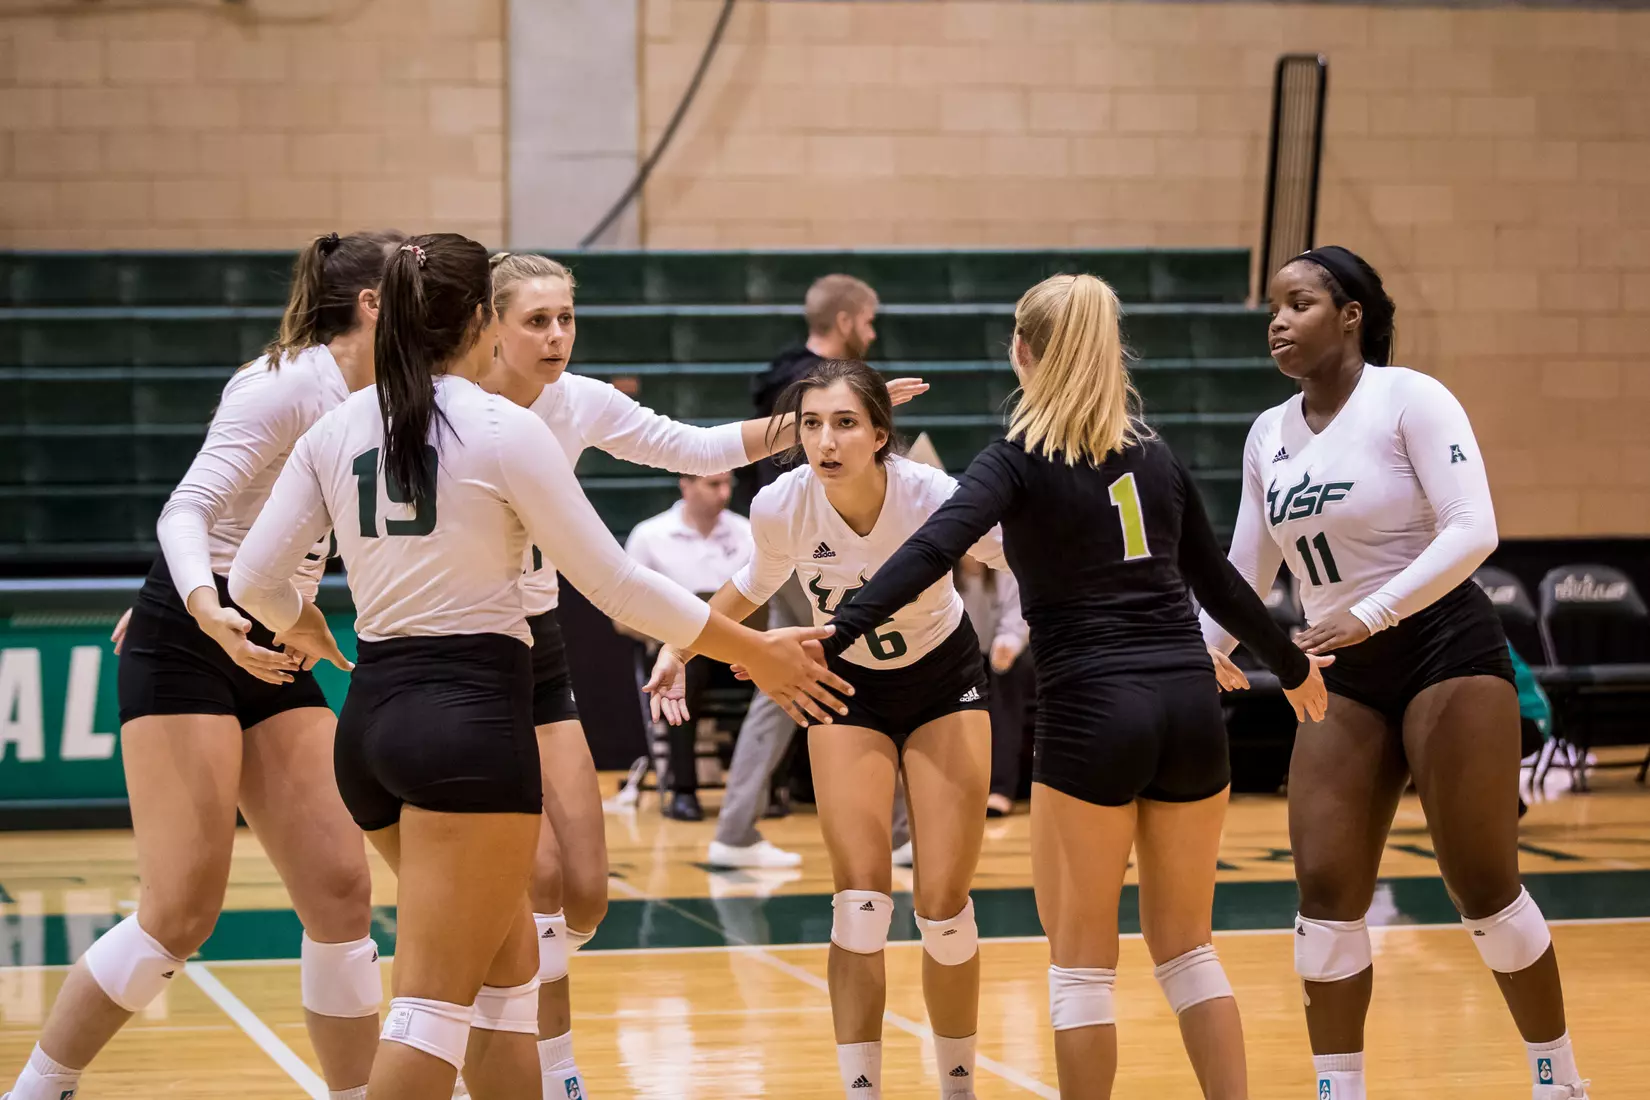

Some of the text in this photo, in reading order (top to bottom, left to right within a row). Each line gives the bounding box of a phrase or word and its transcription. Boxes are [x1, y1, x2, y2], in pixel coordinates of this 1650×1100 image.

[1272, 454, 1289, 463] adidas
[352, 445, 439, 538] 19
[1108, 472, 1152, 561] 1
[1267, 470, 1356, 527] USF
[812, 550, 836, 558] adidas
[1296, 532, 1343, 586] 11
[863, 617, 908, 661] 6
